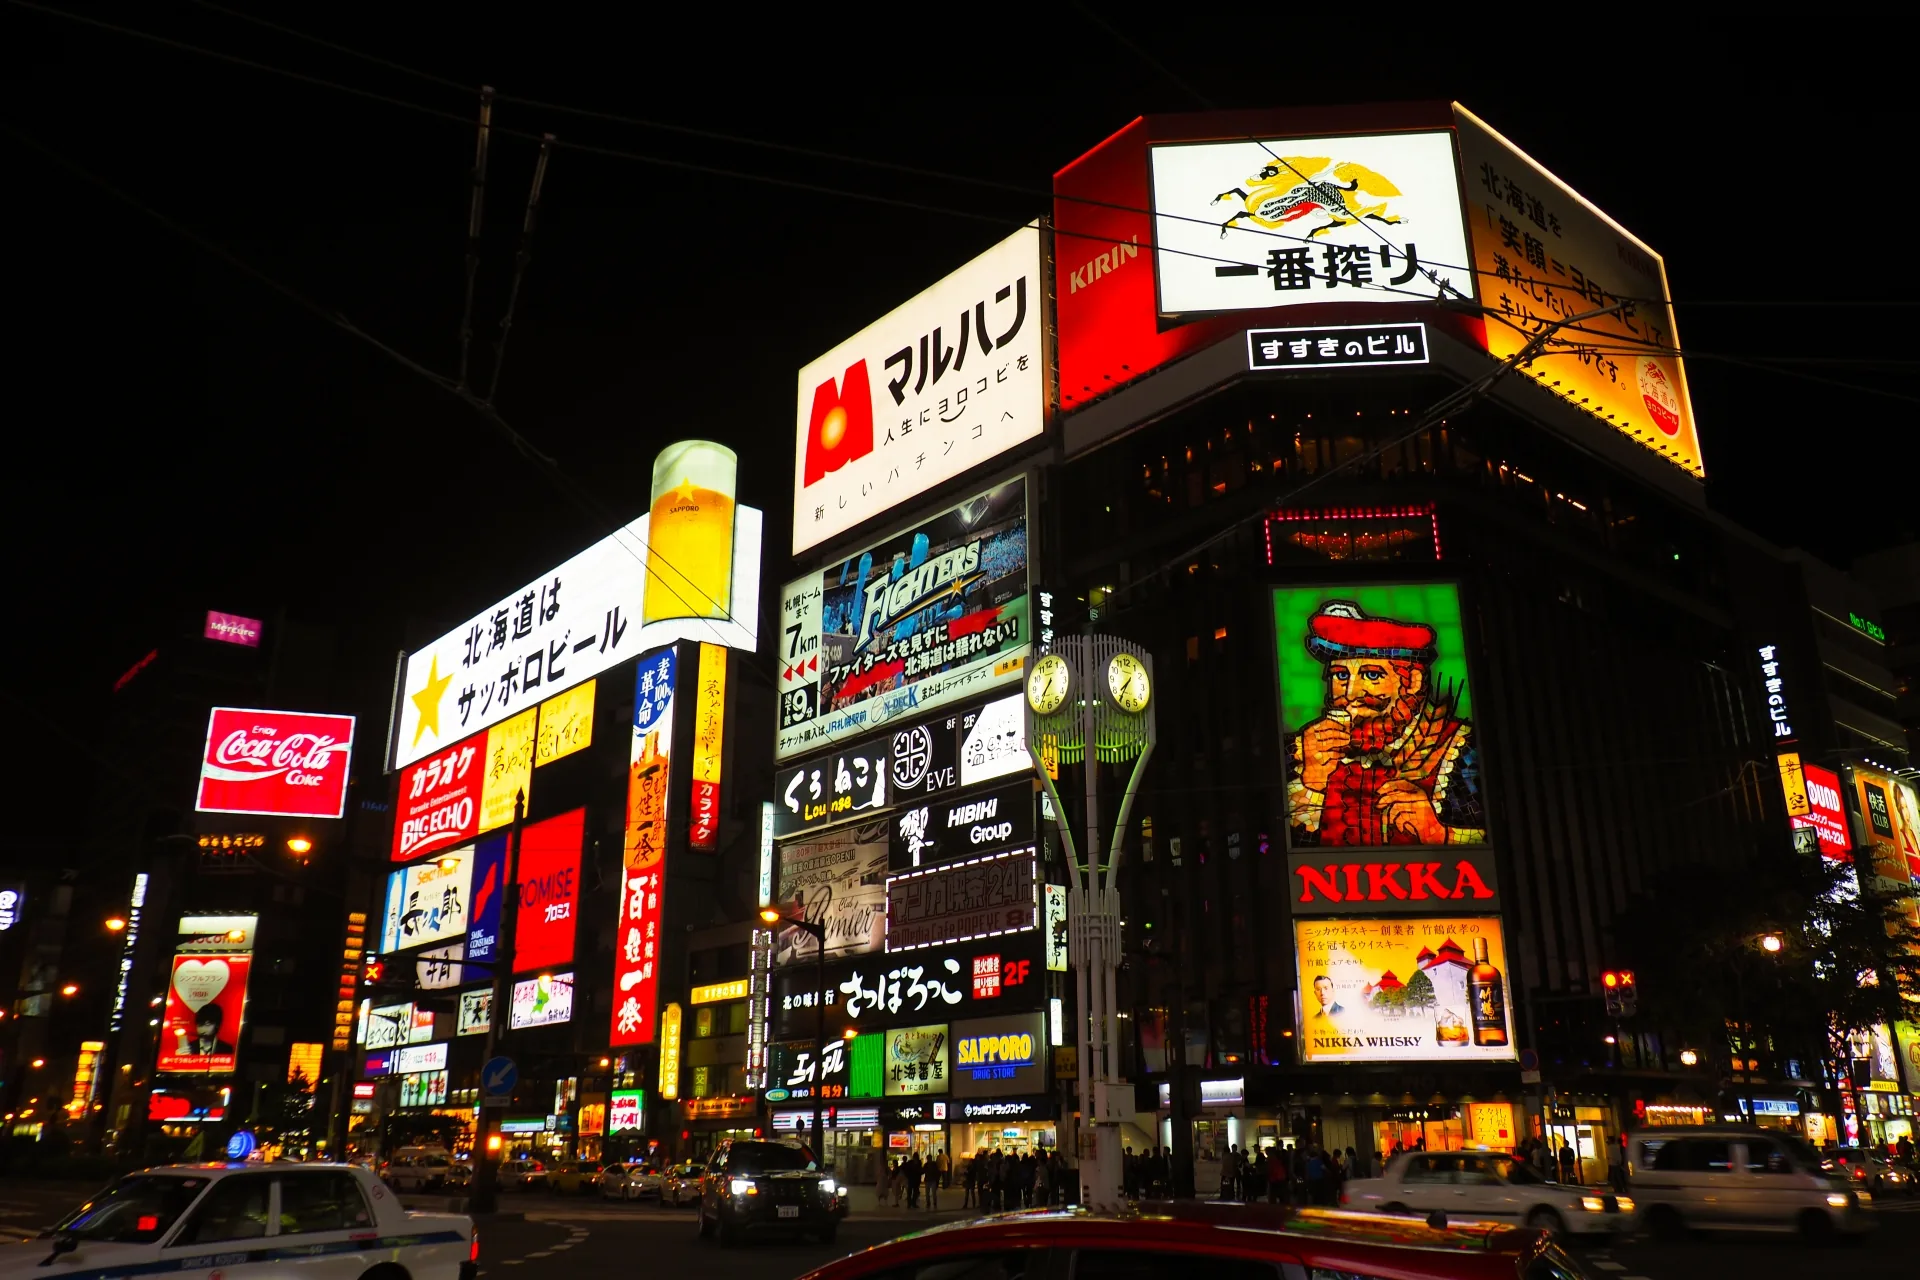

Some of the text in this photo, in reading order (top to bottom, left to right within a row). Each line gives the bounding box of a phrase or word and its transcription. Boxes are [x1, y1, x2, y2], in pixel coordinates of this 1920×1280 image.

[1070, 234, 1140, 295] KIRIN
[1214, 242, 1419, 292] 一番搾り
[884, 275, 1026, 407] マルハン
[1260, 334, 1416, 361] すすきのビル
[884, 353, 1029, 447] 人生にヨロコビを
[814, 410, 1015, 523] 新しいパチンコへ
[669, 505, 700, 515] SAPPORO
[785, 587, 821, 613] 札幌ドーム
[853, 539, 983, 656] FIGHTERS
[463, 576, 562, 669] 北海道は
[796, 605, 810, 620] まで
[211, 621, 256, 638] Mercure
[457, 605, 629, 728] サッポロビール
[830, 624, 949, 684] ファイターズを見ずに
[1045, 660, 1053, 669] 12
[1123, 658, 1131, 668] 12
[637, 668, 655, 726] 革命
[791, 688, 814, 722] 9分
[921, 682, 942, 701] または
[1759, 644, 1791, 738] すすきのビル
[251, 725, 278, 736] Enjoy
[946, 717, 956, 730] 8F
[963, 713, 976, 730] 2F
[216, 729, 336, 771] Coca-Cola
[285, 769, 324, 787] Coke
[409, 744, 477, 801] カラオケ
[784, 757, 870, 814] くろねこ
[926, 766, 957, 793] EVE
[804, 795, 853, 822] Lounge
[1807, 779, 1841, 813] OUND
[402, 817, 429, 854] BIG
[428, 796, 474, 833] ECHO
[699, 783, 713, 840] カラオケ
[947, 798, 998, 828] HIBIKI
[969, 822, 1012, 845] Group
[517, 867, 574, 909] ROMISE
[891, 858, 1034, 925] マンガ喫茶24H
[1294, 859, 1495, 904] NIKKA
[544, 902, 571, 924] プロミス
[957, 912, 1001, 937] POPEYE
[468, 946, 489, 959] FINANCE
[469, 935, 495, 949] CONSUMER
[973, 956, 1000, 975] 炭火焼き
[1003, 959, 1030, 987] 2F
[839, 958, 963, 1019] さっぽろっこ
[958, 1033, 1033, 1065] SAPPORO
[1313, 1035, 1423, 1049] NIKKA WHISKY
[891, 1060, 944, 1082] 北海番屋
[972, 1066, 1016, 1081] DRUG STORE
